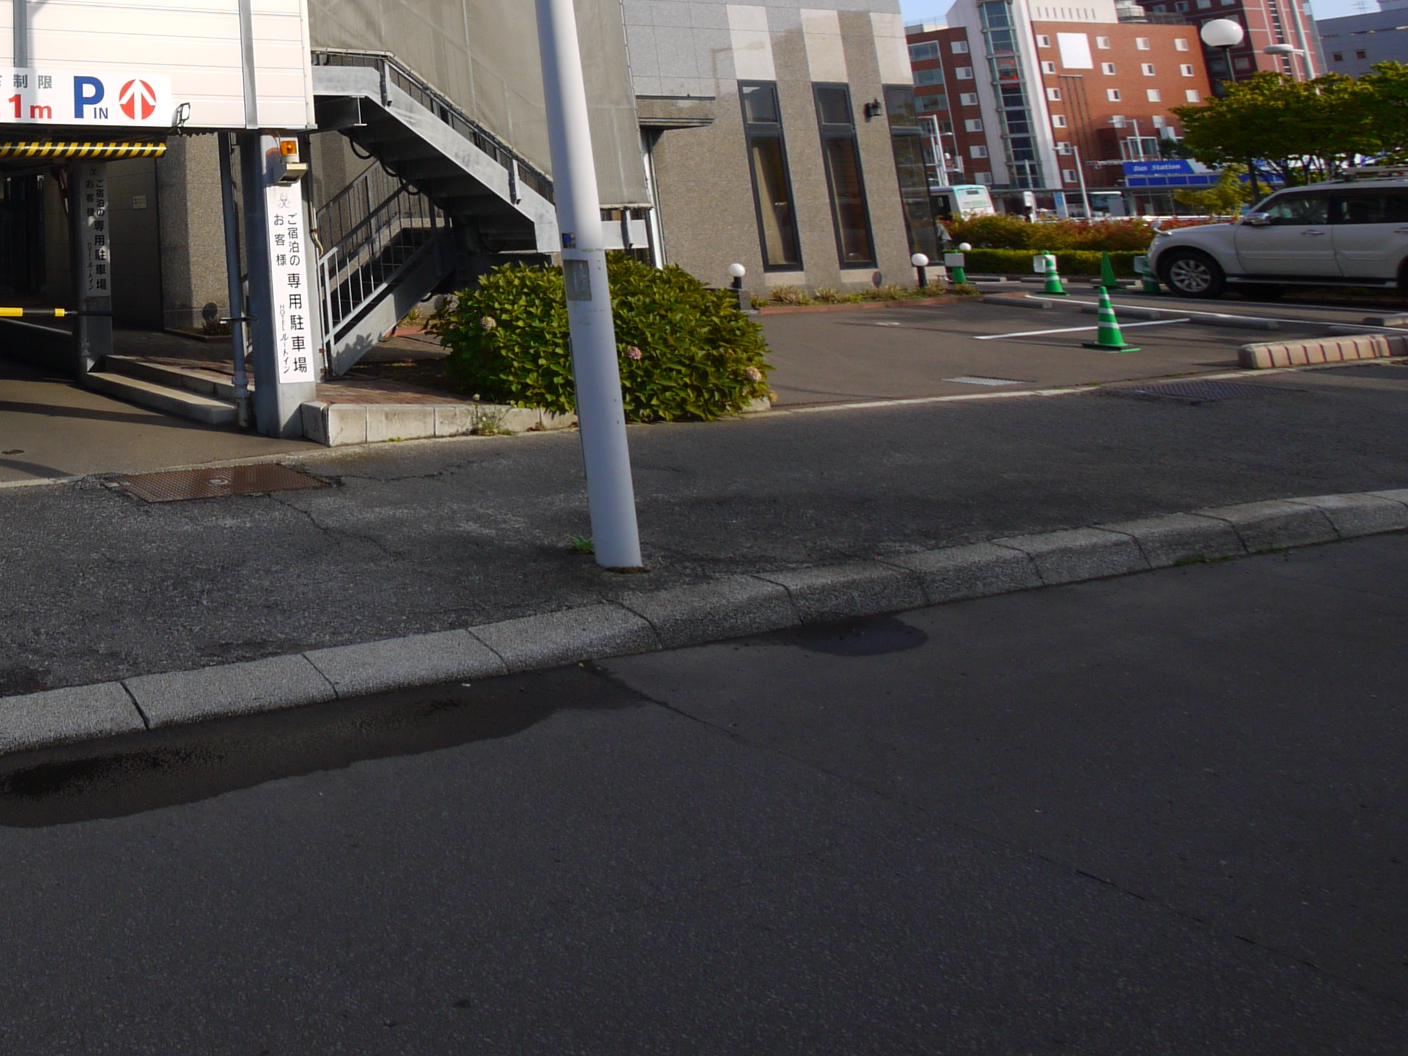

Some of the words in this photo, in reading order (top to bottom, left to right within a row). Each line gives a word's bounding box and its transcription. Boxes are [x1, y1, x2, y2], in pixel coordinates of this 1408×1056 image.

[74, 75, 105, 119] P
[93, 107, 109, 119] IN
[1133, 164, 1148, 172] Bus
[1151, 163, 1182, 172] Station
[273, 213, 287, 267] お客様
